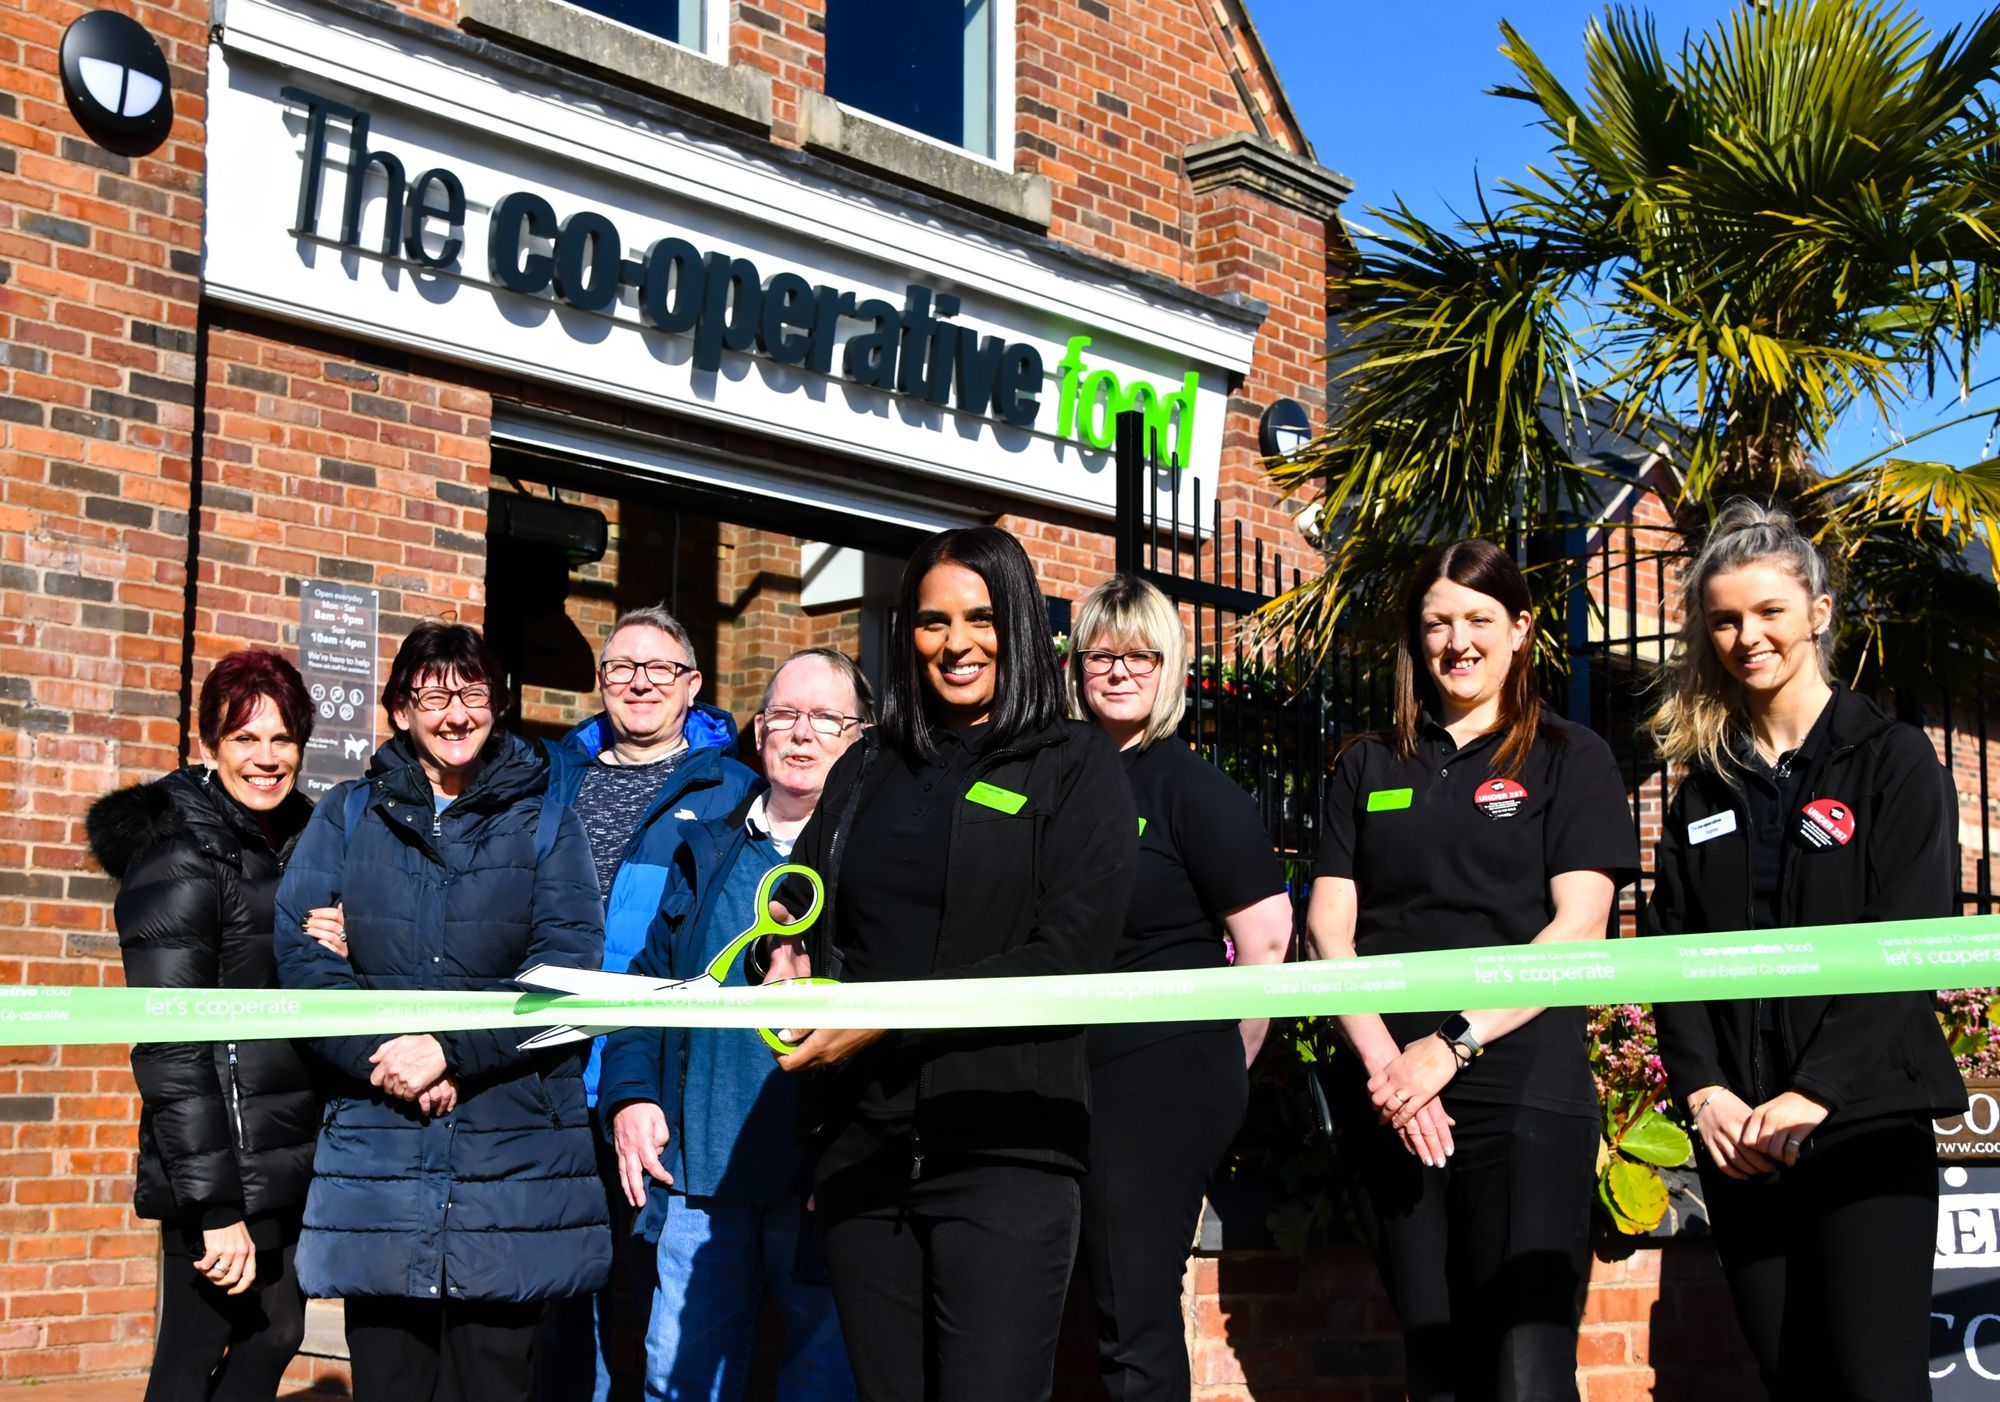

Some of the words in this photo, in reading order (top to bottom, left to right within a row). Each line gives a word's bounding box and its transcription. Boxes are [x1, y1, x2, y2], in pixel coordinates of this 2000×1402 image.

[281, 86, 466, 268] The
[488, 191, 1043, 425] co-operative
[1058, 335, 1199, 469] food
[314, 588, 334, 599] Open
[334, 592, 364, 604] everyday
[321, 600, 339, 610] Mon
[343, 603, 356, 613] Sat
[314, 609, 336, 621] 8am
[342, 613, 364, 627] 9pm
[331, 625, 346, 635] Sun
[310, 632, 338, 645] 10am
[344, 637, 367, 650] 4pm
[307, 651, 329, 662] We're
[329, 653, 346, 664] here
[346, 656, 354, 665] to
[354, 657, 371, 669] help
[308, 779, 321, 789] For
[1478, 792, 1508, 802] UNDER
[1807, 806, 1835, 831] UNDER
[1883, 948, 1923, 966] let's
[1475, 964, 1513, 984] let's
[1520, 963, 1616, 986] cooperate
[145, 996, 188, 1016] let's
[194, 997, 300, 1019] cooperate
